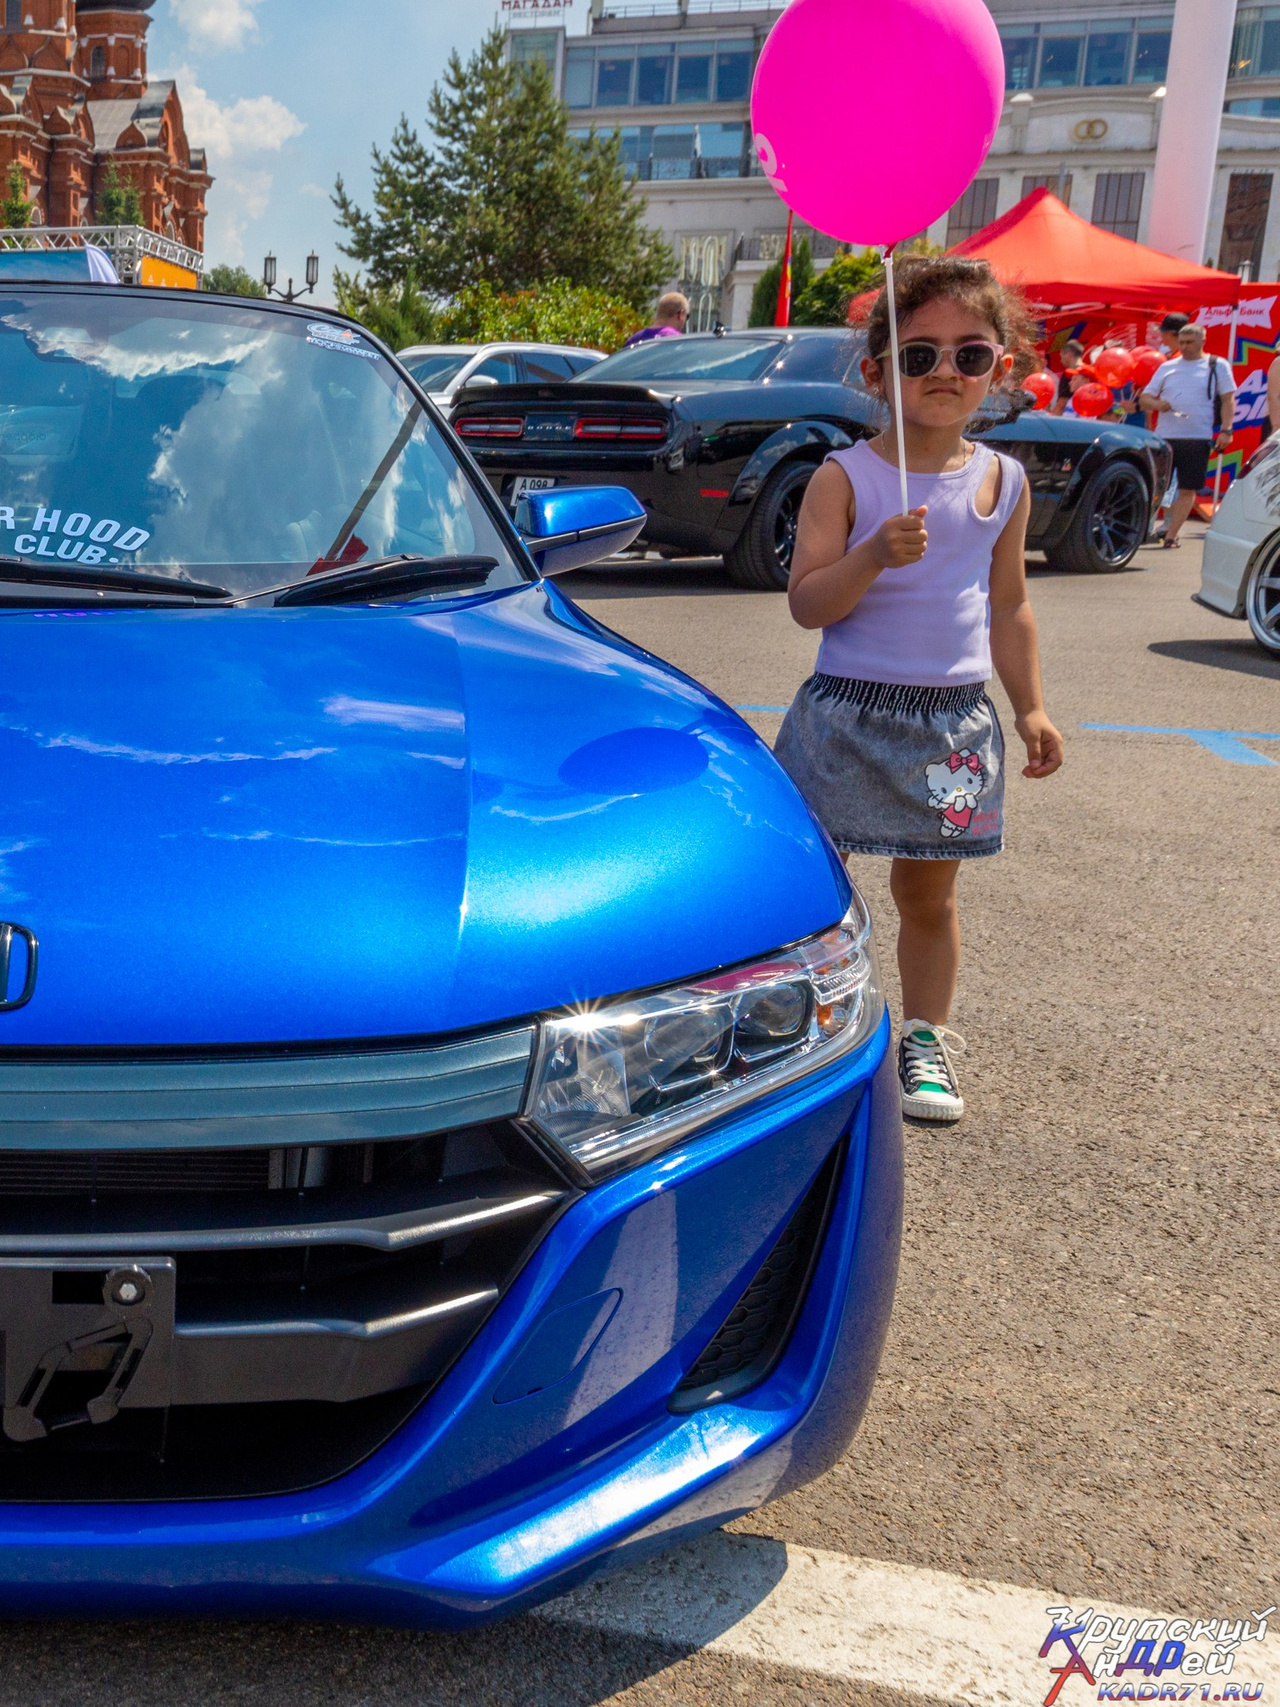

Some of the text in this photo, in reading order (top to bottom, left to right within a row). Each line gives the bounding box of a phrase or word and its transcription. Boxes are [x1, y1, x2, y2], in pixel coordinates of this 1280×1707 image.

[1204, 307, 1265, 317] Альф Банк
[31, 507, 151, 551] HOOD
[14, 534, 108, 565] CLUB
